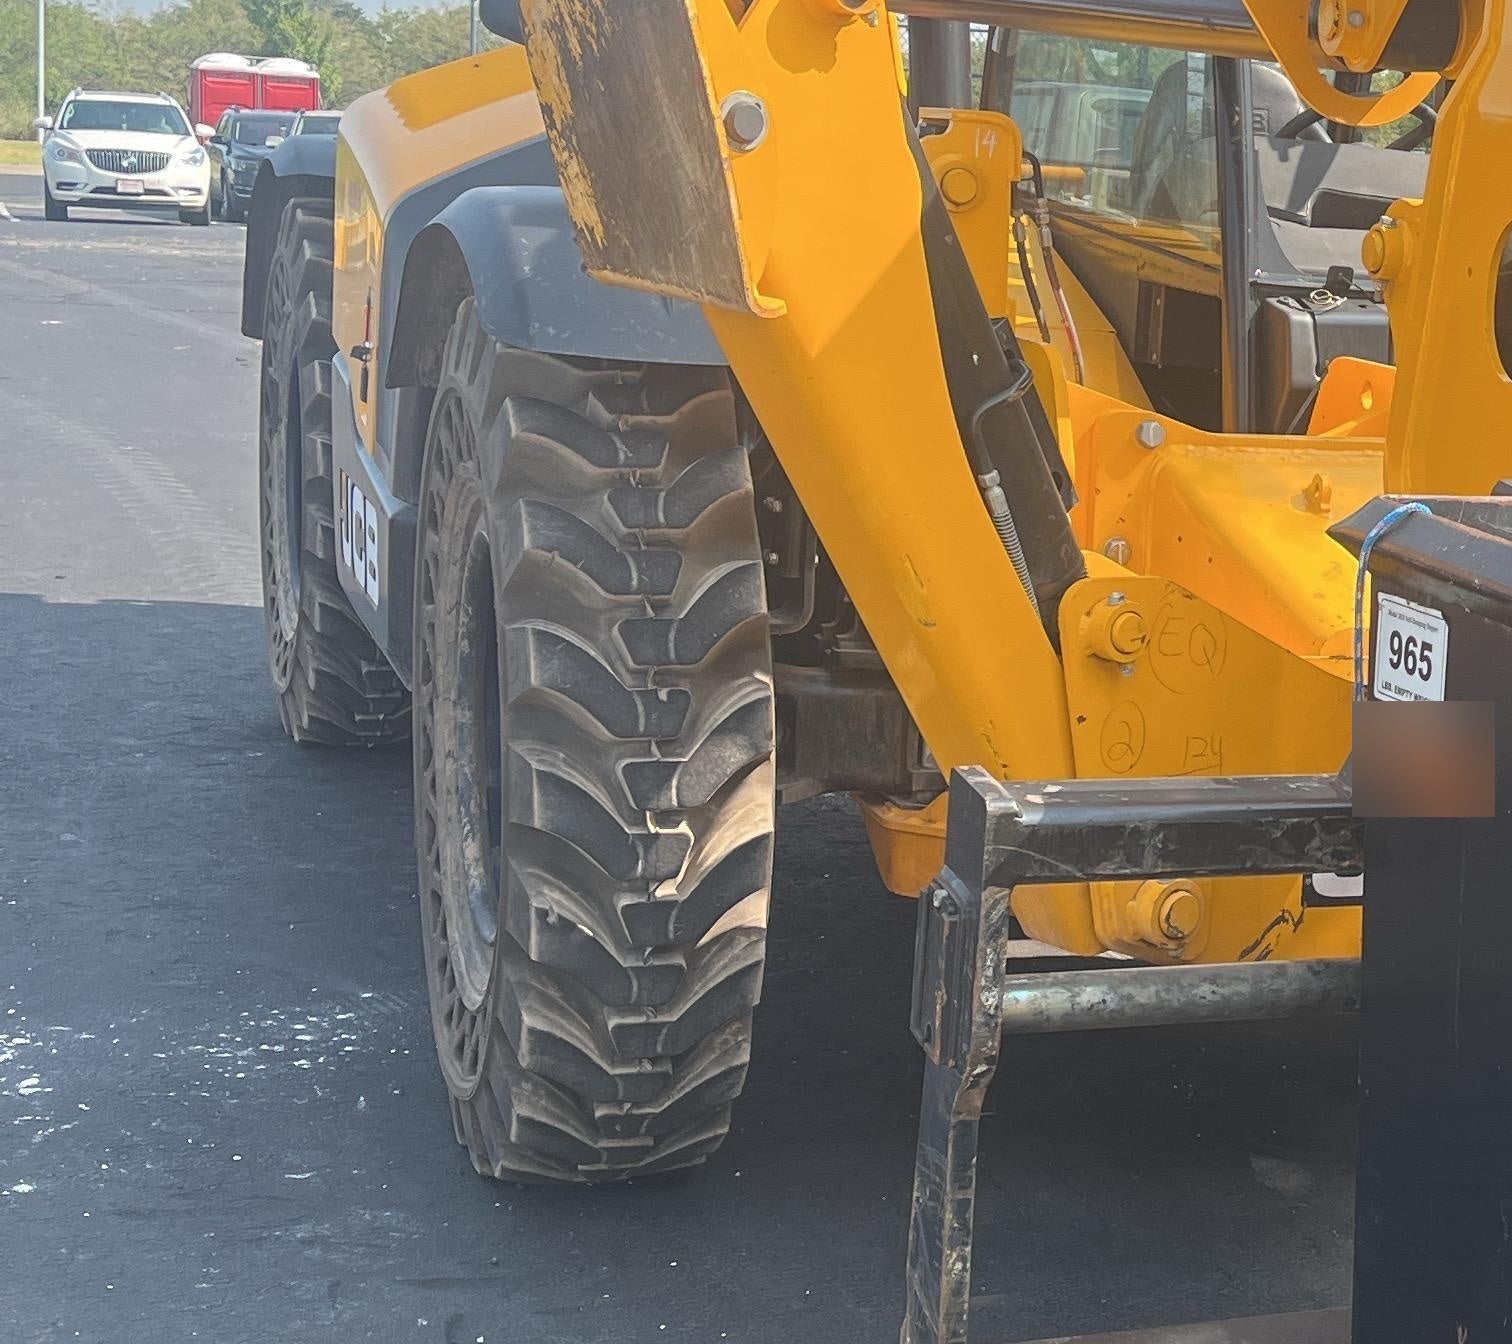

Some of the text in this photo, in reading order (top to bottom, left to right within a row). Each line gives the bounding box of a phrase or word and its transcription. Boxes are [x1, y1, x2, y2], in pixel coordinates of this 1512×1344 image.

[975, 127, 998, 160] 14
[340, 472, 380, 607] JCB
[1157, 617, 1217, 673] EQ
[1389, 629, 1433, 682] 965
